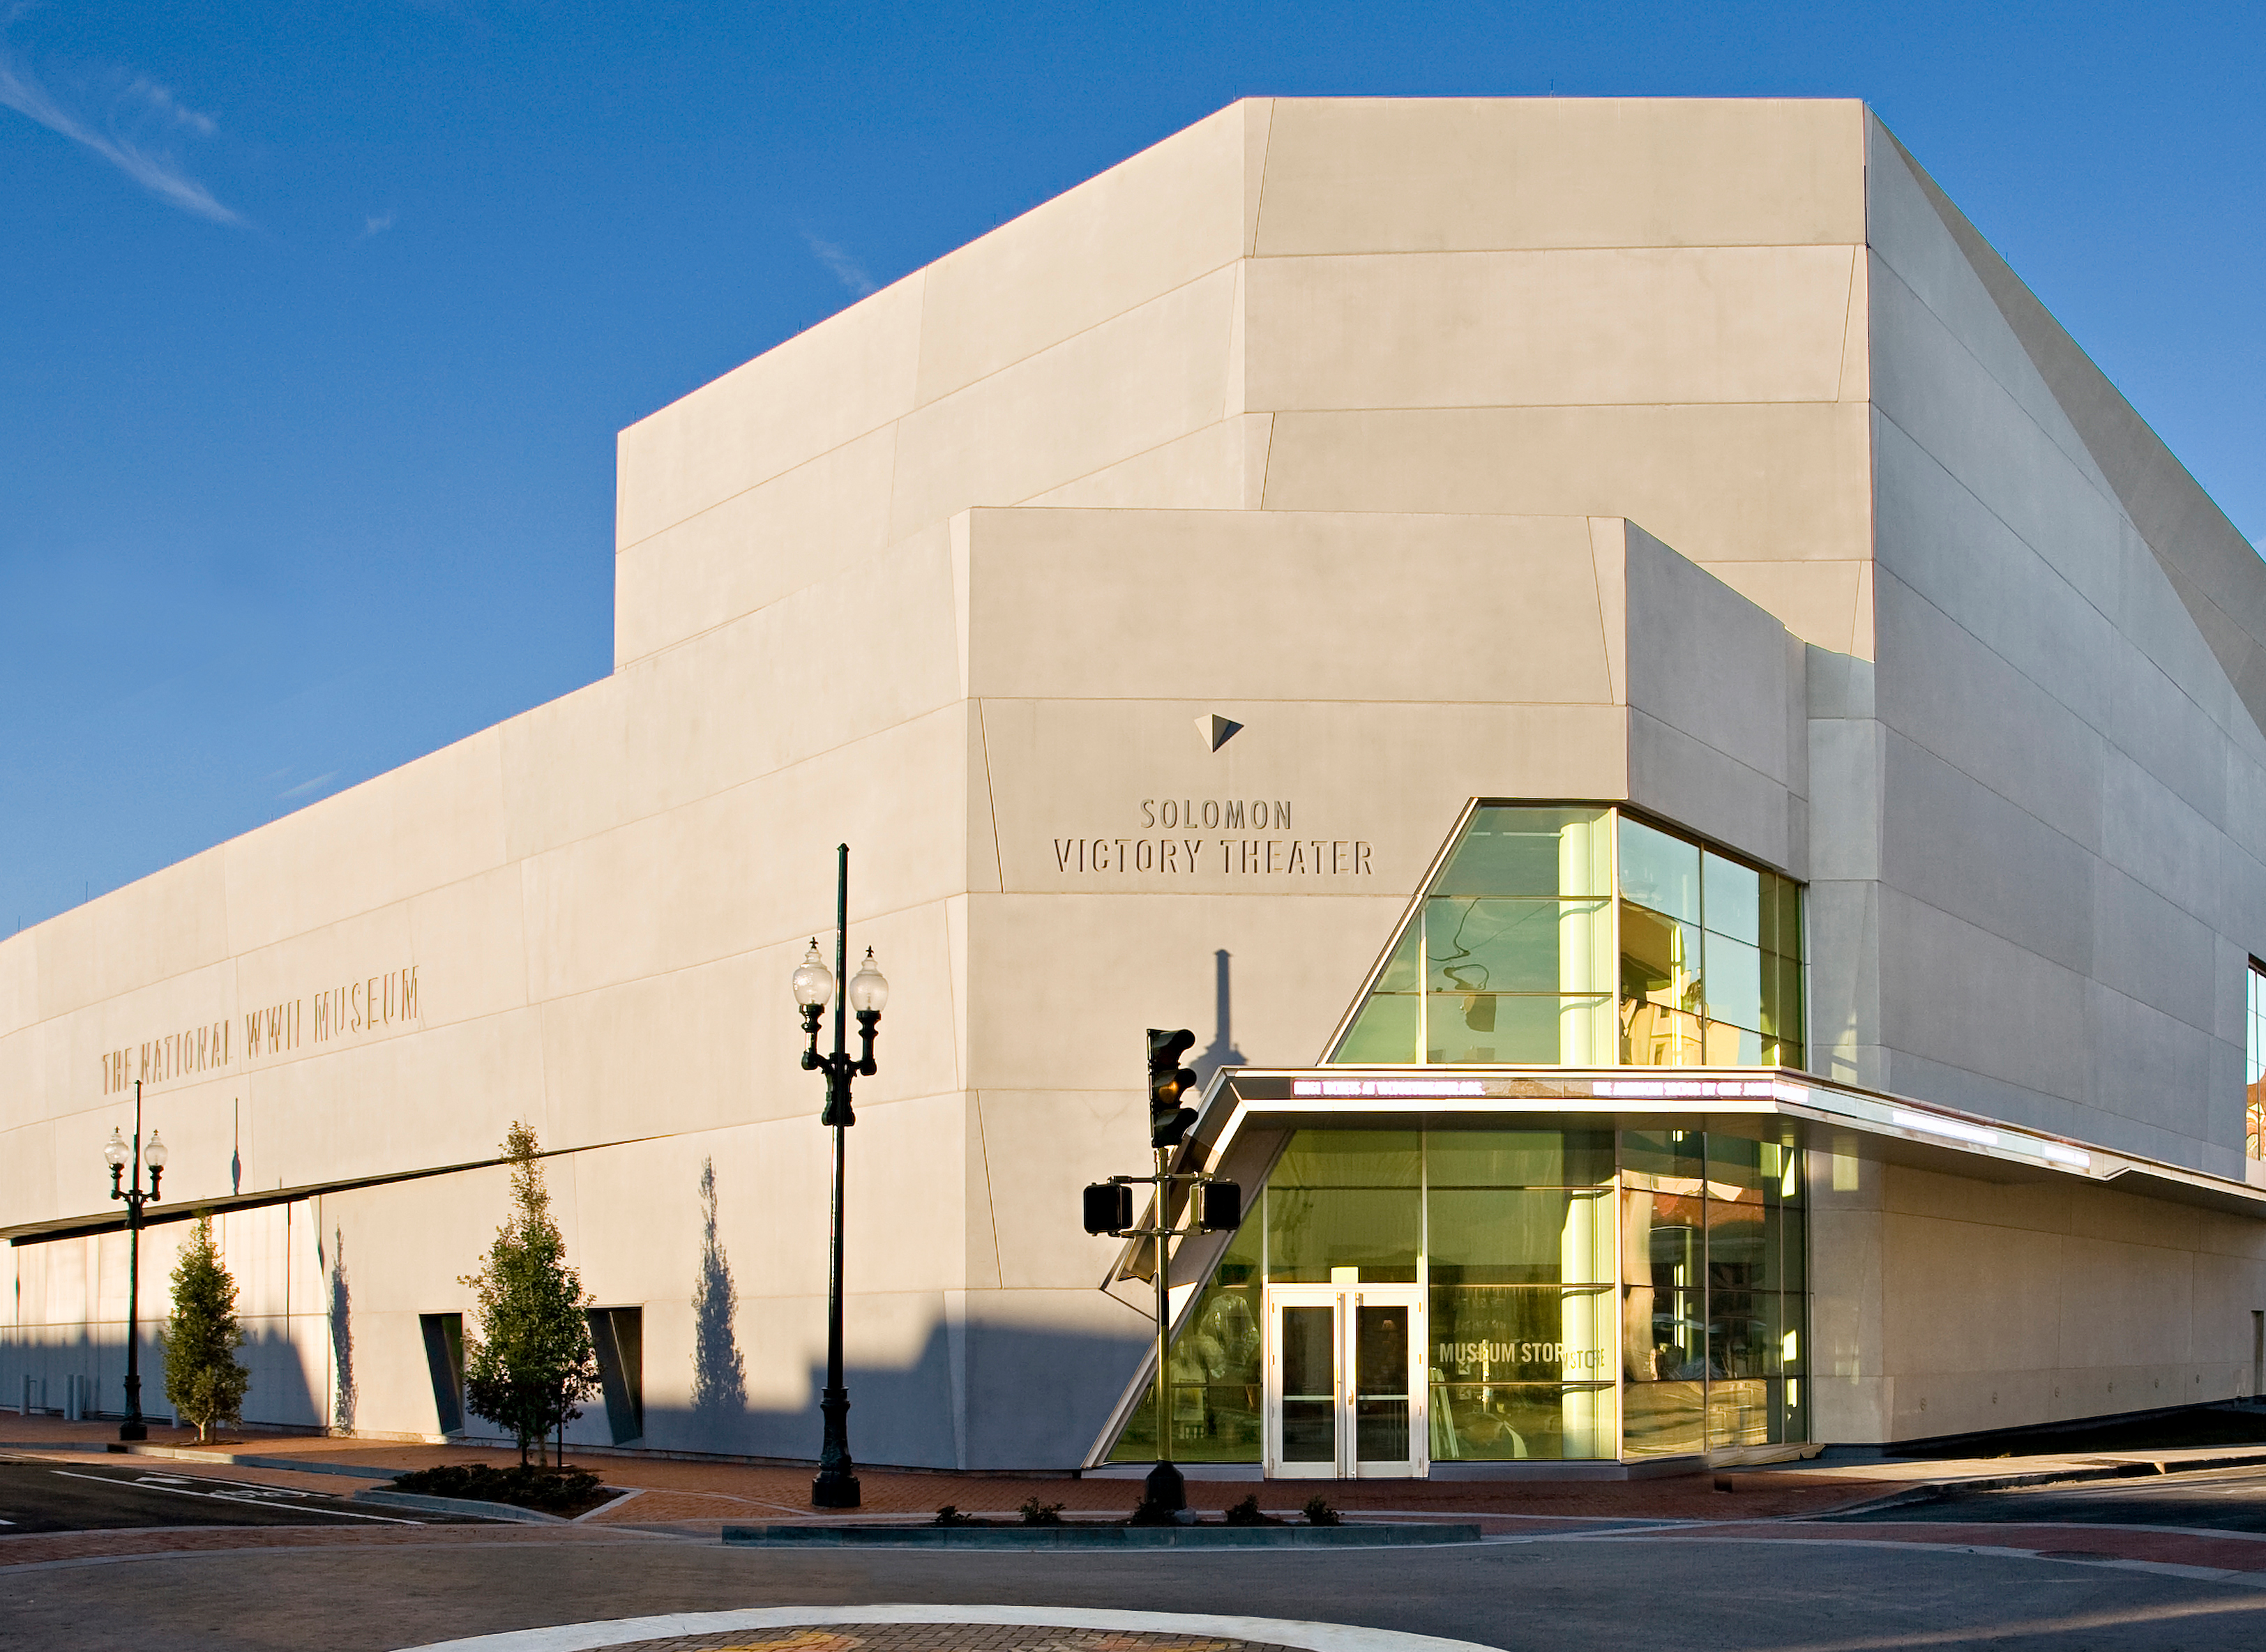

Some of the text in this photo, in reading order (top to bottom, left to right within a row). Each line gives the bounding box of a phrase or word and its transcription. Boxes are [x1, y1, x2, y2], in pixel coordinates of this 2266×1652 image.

[1140, 798, 1292, 830] SOLOMON
[1054, 838, 1375, 875] VICTORY THEATER
[103, 964, 420, 1095] THE NATIONAL WWII MUSEUM
[1439, 1342, 1516, 1363] MUSEUM
[1520, 1342, 1575, 1363] STOR
